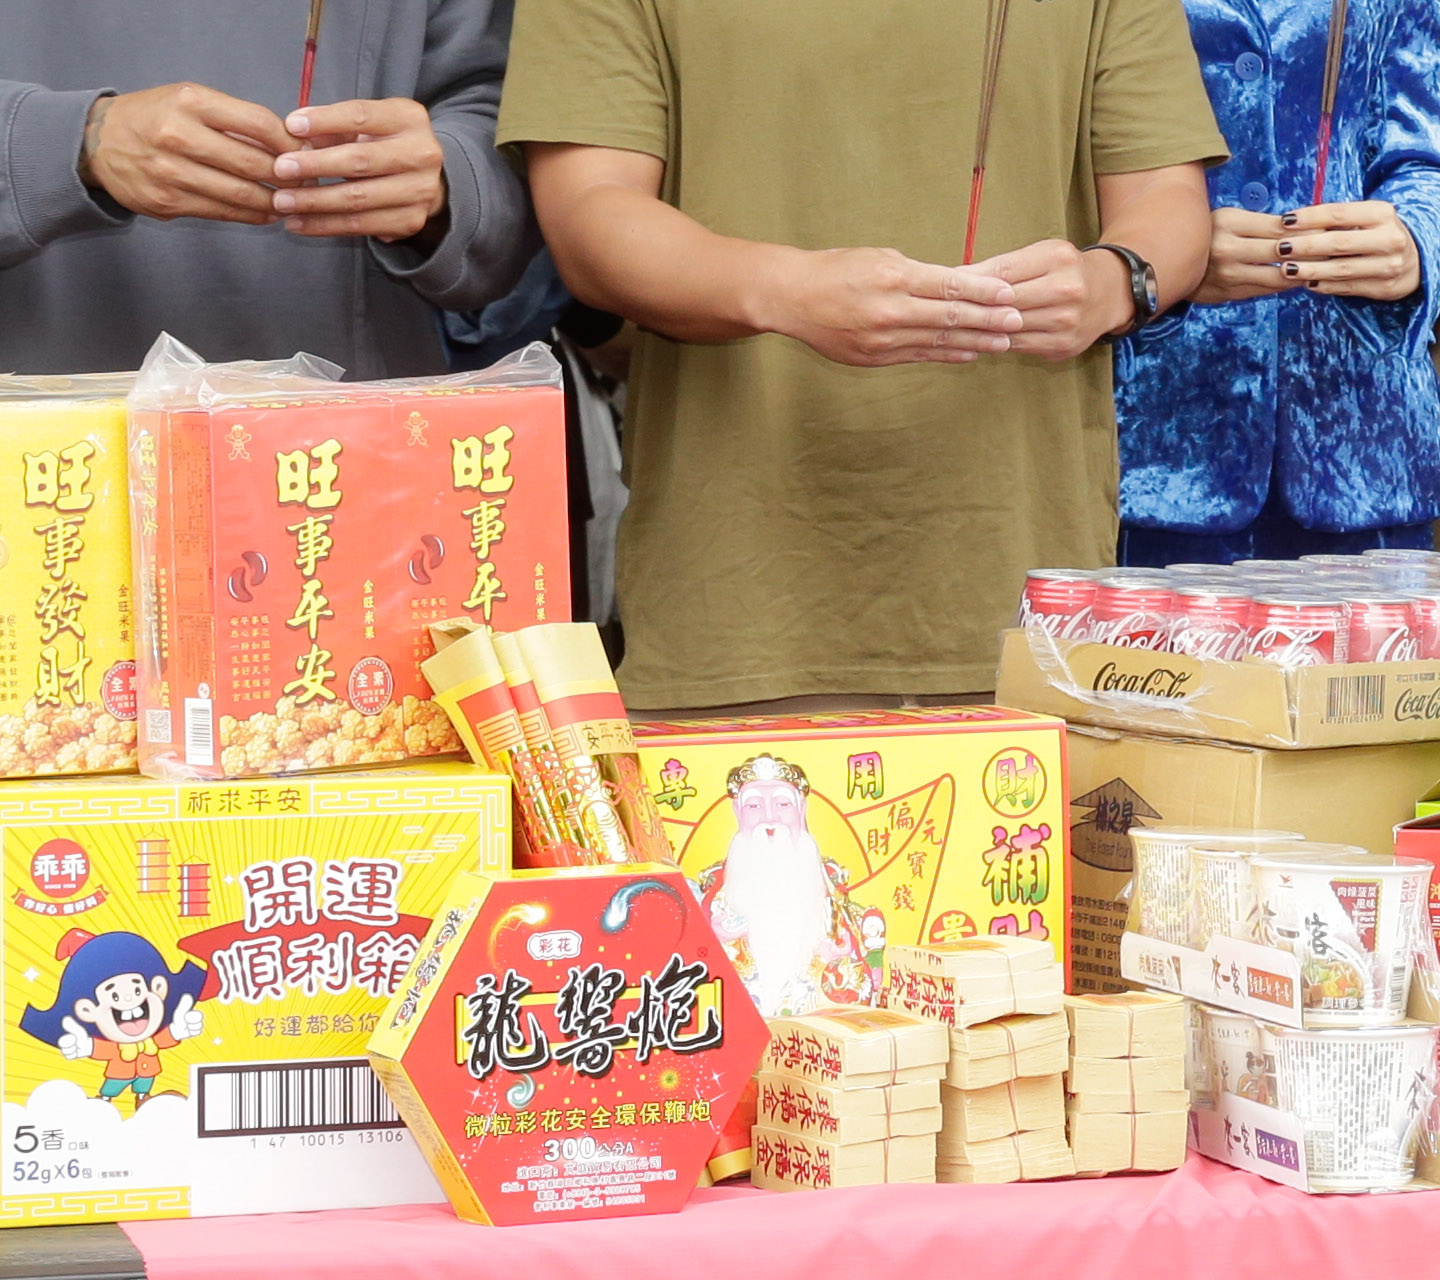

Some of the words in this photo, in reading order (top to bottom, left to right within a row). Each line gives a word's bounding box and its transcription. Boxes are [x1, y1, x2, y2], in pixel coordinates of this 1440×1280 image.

[451, 425, 515, 634] 旺事平
[22, 440, 97, 707] 旺事發財
[276, 437, 344, 706] 旺事平安
[186, 787, 303, 816] 祈求平安
[846, 750, 885, 802] 用
[992, 753, 1041, 810] 財
[33, 852, 89, 884] 乖乖
[242, 856, 404, 932] 開運
[210, 931, 419, 1004] 順利箱
[537, 936, 574, 954] 彩花
[253, 1013, 380, 1039] 好運都給你
[13, 1125, 66, 1154] 5香
[465, 1098, 712, 1139] 微粒彩花安全環保鞭炮
